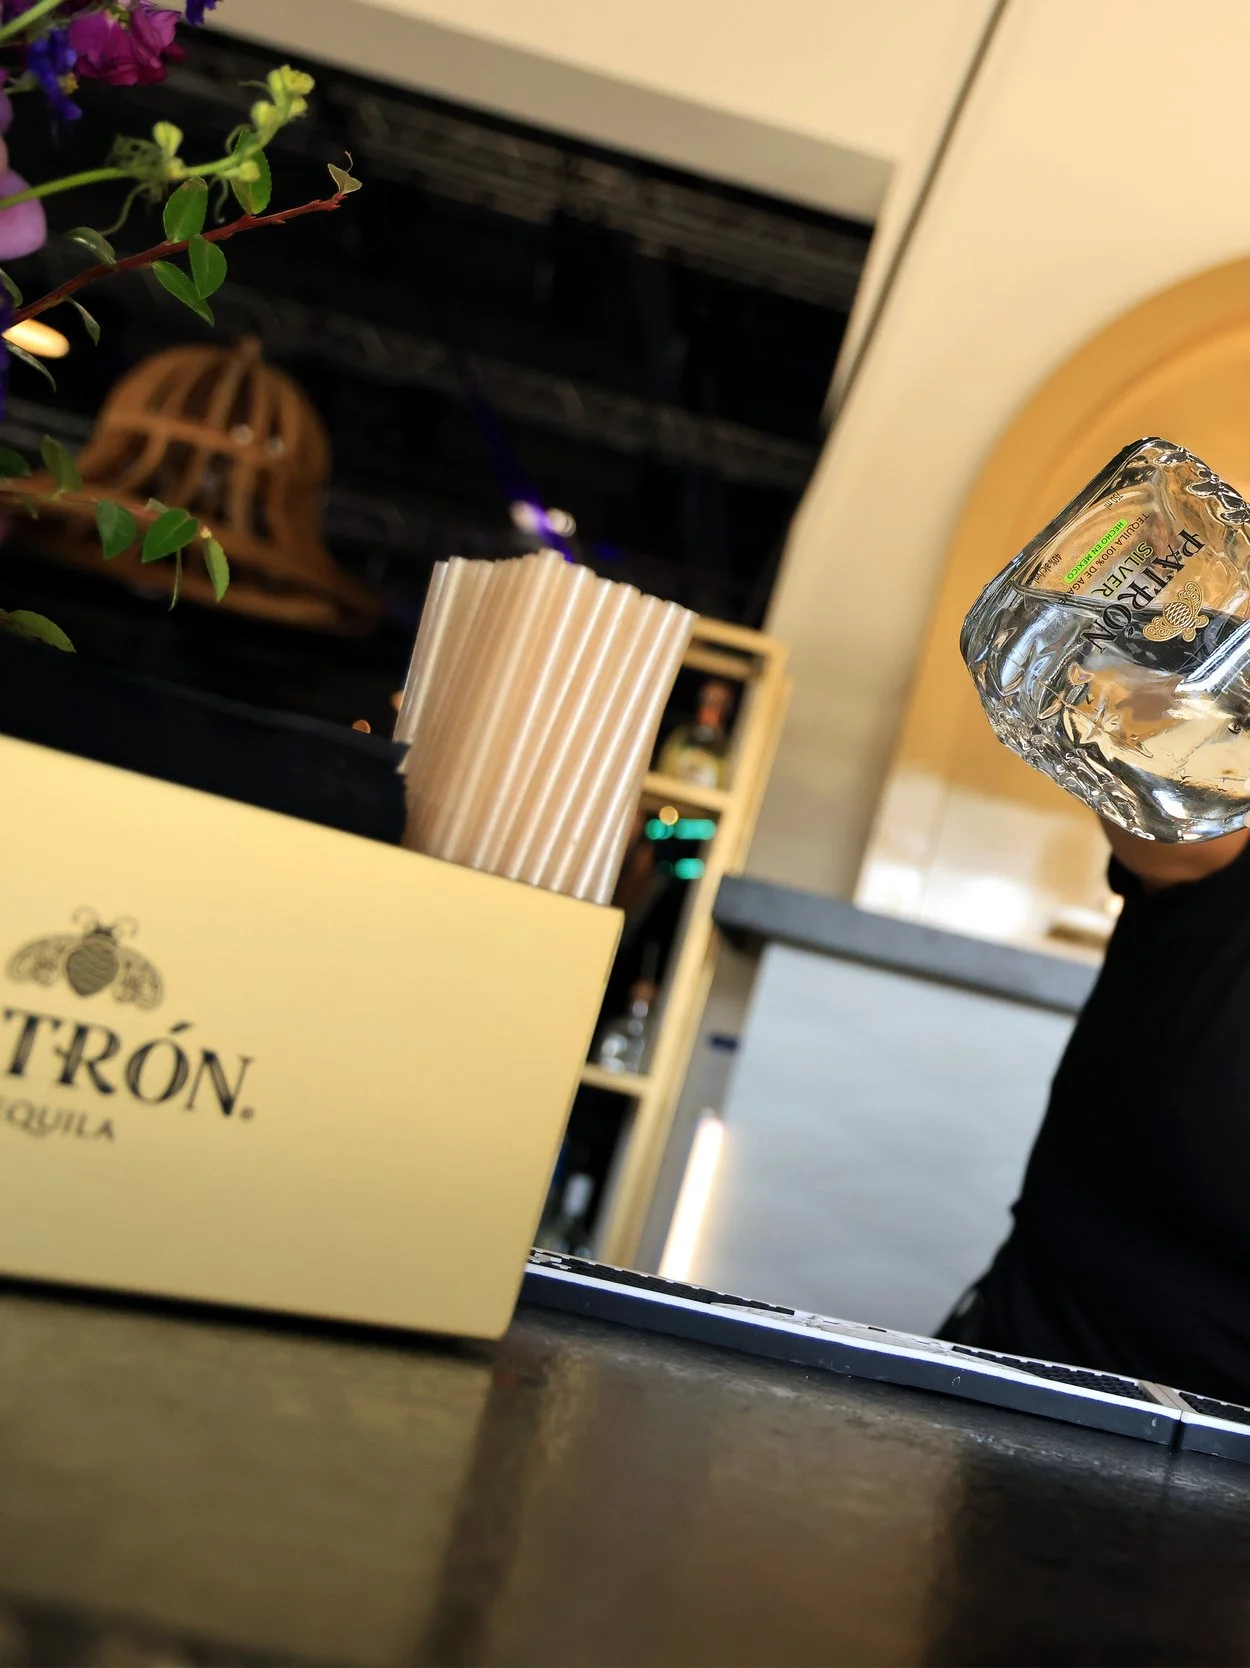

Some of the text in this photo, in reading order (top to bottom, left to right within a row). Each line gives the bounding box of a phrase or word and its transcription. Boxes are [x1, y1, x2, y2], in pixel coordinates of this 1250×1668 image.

[1101, 521, 1124, 545] HECHO
[1114, 513, 1149, 547] TEQUILA
[1091, 544, 1103, 555] EN
[1095, 545, 1117, 567] 100%
[1083, 566, 1097, 579] DE
[1092, 541, 1153, 599] SILVER
[1082, 528, 1205, 654] PATRÓN
[2, 1006, 254, 1119] TRÓN
[0, 1095, 116, 1142] QUILA
